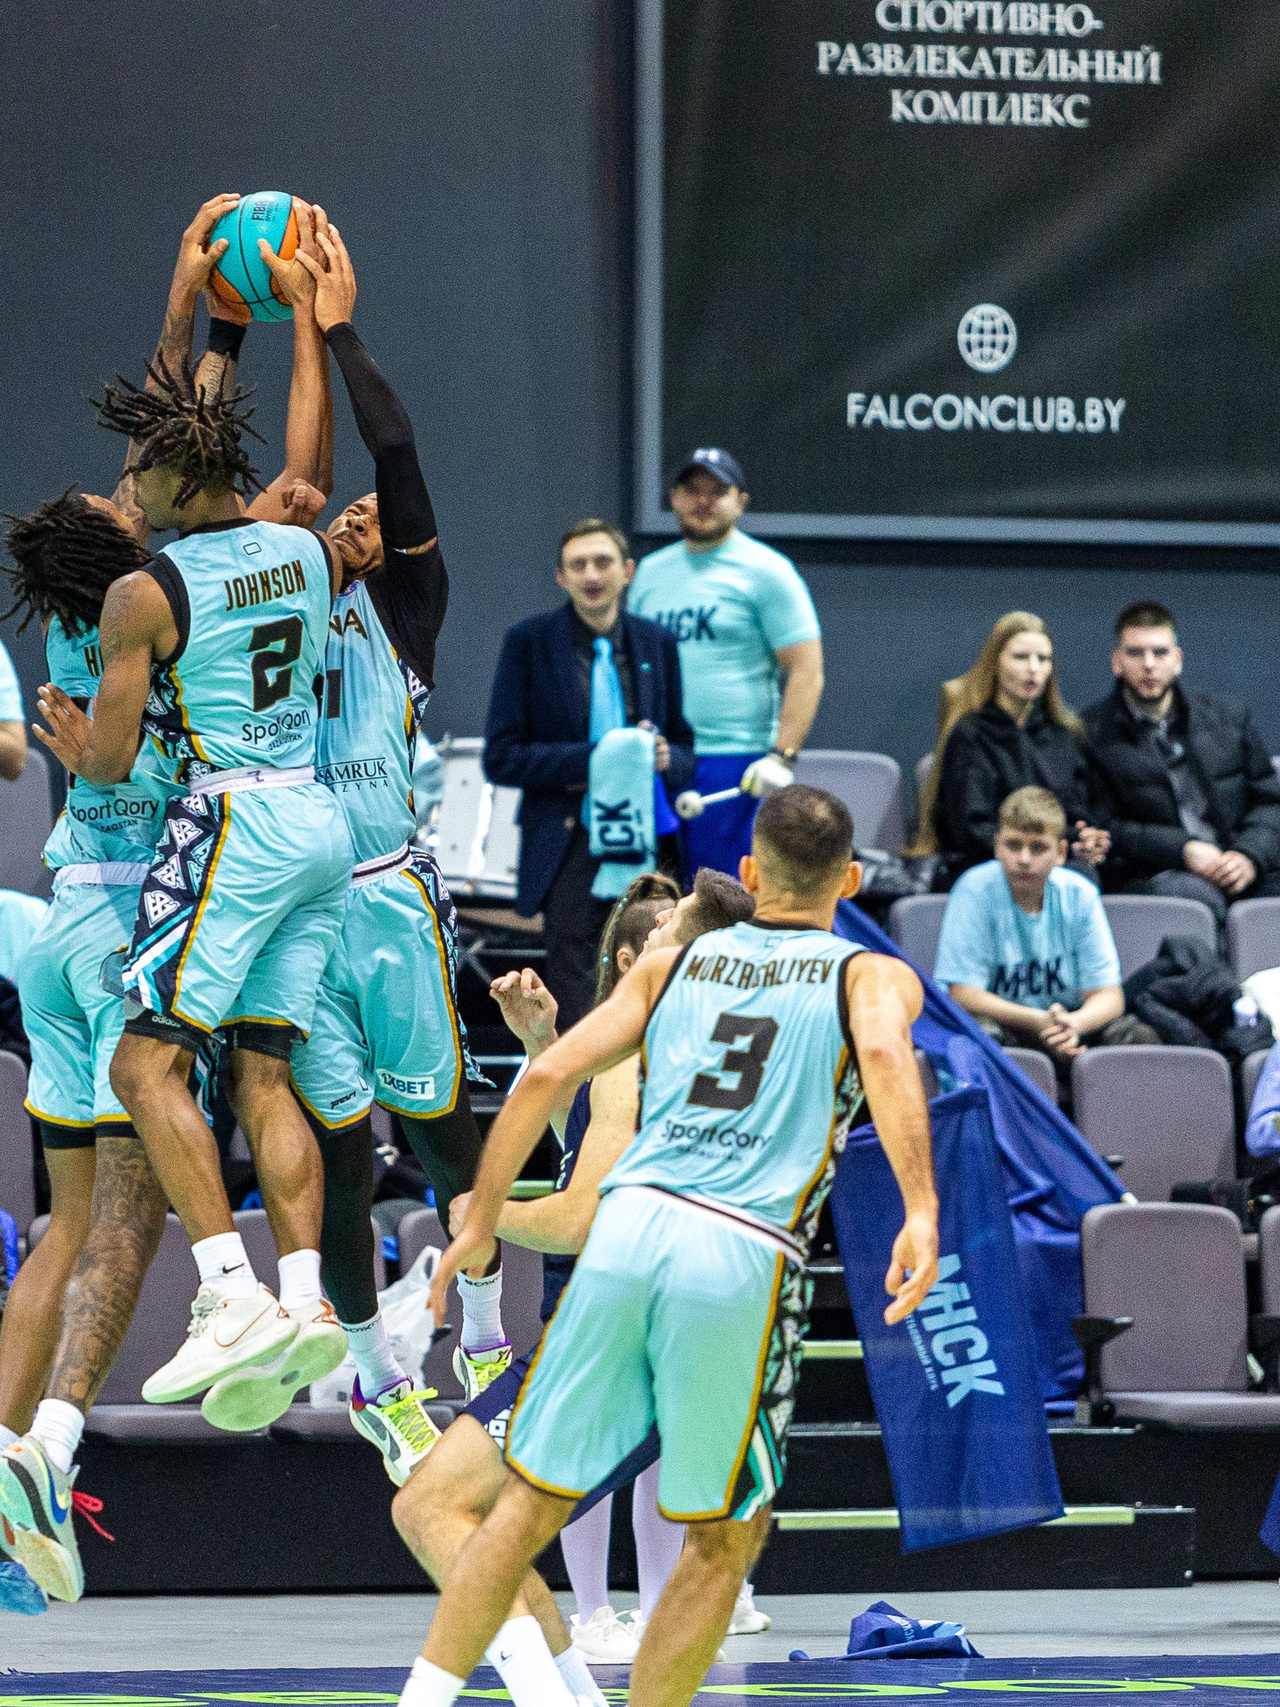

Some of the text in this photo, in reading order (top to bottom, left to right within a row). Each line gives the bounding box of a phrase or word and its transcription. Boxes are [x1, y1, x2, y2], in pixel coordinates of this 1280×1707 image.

[875, 0, 1104, 38] СПОРТИВНО-
[816, 41, 1163, 85] РАЗВЛЕКАТЕЛЬНЫЙ
[889, 88, 1091, 128] КОМПЛЕКС
[845, 392, 1126, 434] FALCONCLUB.BY
[223, 559, 307, 612] JOHNSON
[246, 614, 304, 713] 2
[318, 759, 389, 785] SAMRUK
[686, 1011, 780, 1112] 3
[380, 1072, 430, 1095] 1XBET
